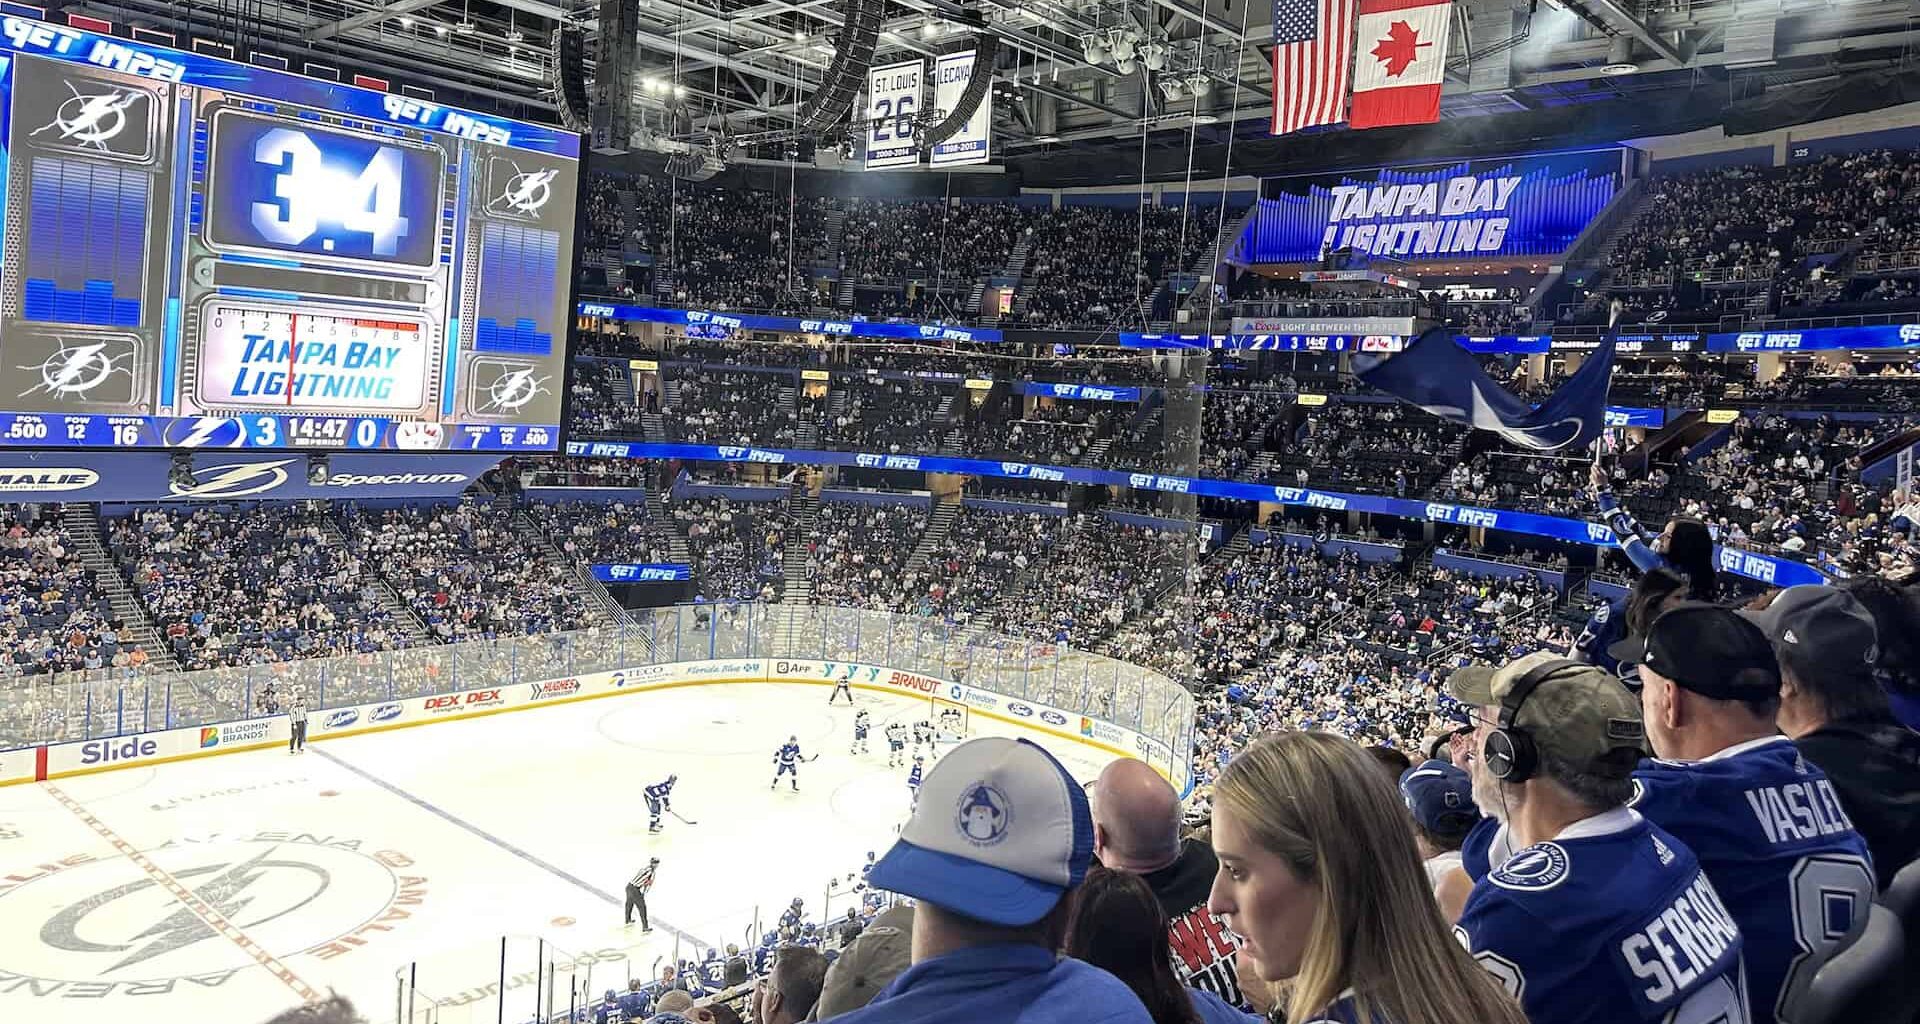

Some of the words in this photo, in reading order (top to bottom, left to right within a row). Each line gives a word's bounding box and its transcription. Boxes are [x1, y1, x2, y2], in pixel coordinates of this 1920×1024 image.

[3, 17, 82, 53] GET
[875, 78, 888, 93] ST.
[891, 72, 917, 91] LOUIS
[940, 65, 971, 84] LECAVA
[384, 95, 439, 124] GET
[873, 96, 913, 141] 26
[251, 127, 408, 256] 3.4
[1330, 184, 1437, 222] TAMPA
[1440, 176, 1522, 216] BAY
[1321, 218, 1509, 257] LIGHTNING
[214, 318, 222, 328] 0
[240, 320, 245, 329] 1
[262, 322, 269, 331] 2
[308, 325, 314, 334] 4
[330, 326, 336, 335] 5
[352, 327, 358, 337] 6
[374, 330, 379, 339] 7
[393, 331, 399, 340] 8
[413, 333, 420, 342] 9
[1281, 323, 1305, 332] LIGHT
[1311, 323, 1351, 332] BETWEEN
[1354, 323, 1368, 332] THE
[1900, 324, 1920, 343] GE
[241, 334, 336, 366] TAMPA
[343, 342, 401, 369] BAY
[1291, 337, 1298, 349] 3
[1336, 337, 1343, 349] 0
[231, 367, 394, 400] LIGHTNING
[4, 423, 47, 438] .500
[67, 424, 86, 439] 12
[108, 418, 144, 426] SHOTS
[255, 417, 276, 446] 3
[289, 418, 348, 437] 14:47
[357, 419, 377, 447] 0
[113, 426, 138, 445] 16
[471, 433, 482, 449] 7
[501, 434, 513, 445] 12
[521, 434, 548, 445] .500
[327, 473, 468, 487] Spectrum
[628, 667, 663, 677] TECO
[888, 672, 941, 693] BRANDT
[543, 679, 575, 692] HUGHES
[424, 695, 461, 709] DEX
[466, 690, 502, 703] DEX
[81, 737, 157, 765] Slide
[1744, 780, 1853, 843] VASILE
[1168, 905, 1233, 974] WE
[0, 968, 238, 999] AREN
